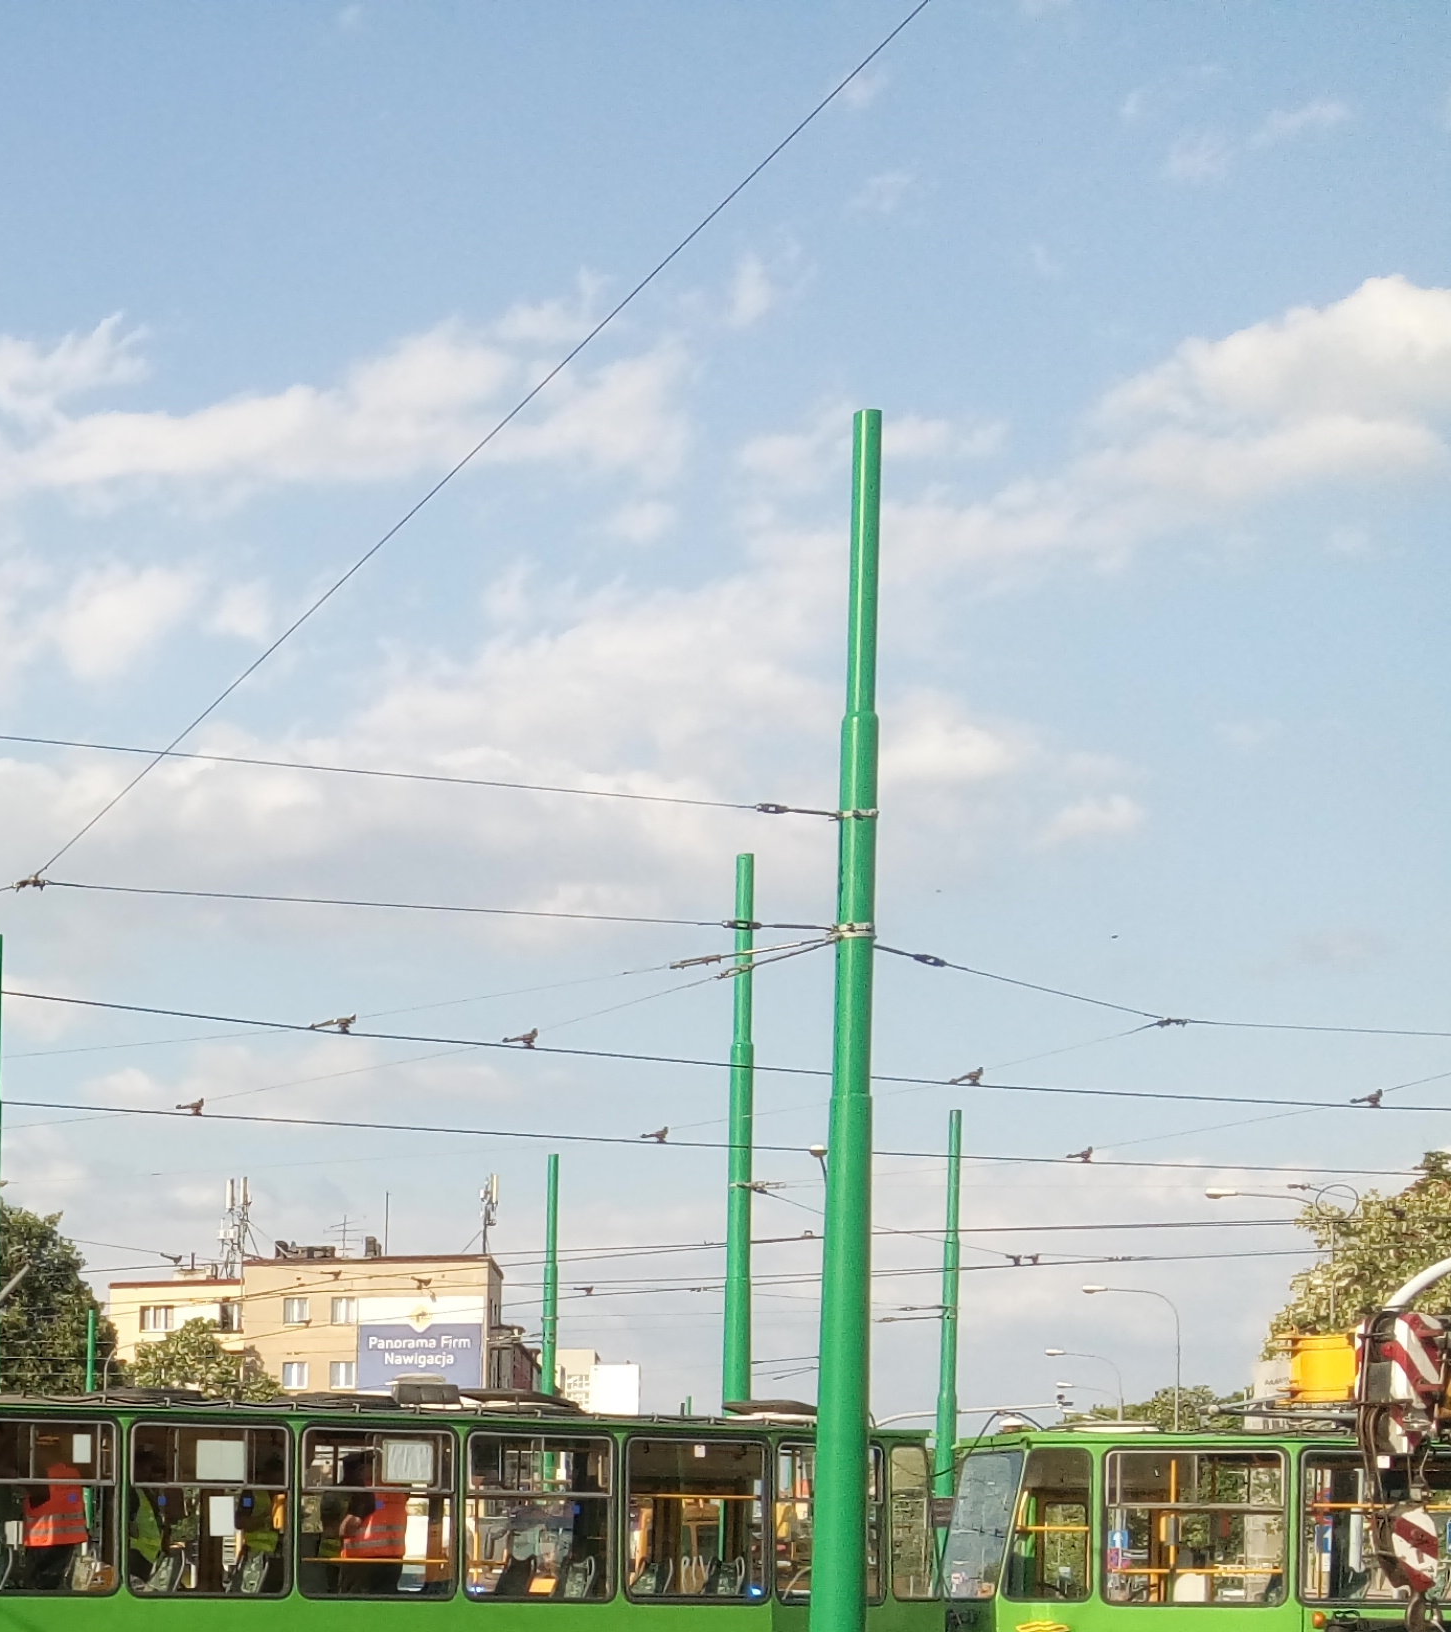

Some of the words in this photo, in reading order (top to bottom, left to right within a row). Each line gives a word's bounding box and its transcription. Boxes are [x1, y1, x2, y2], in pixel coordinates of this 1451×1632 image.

[368, 1336, 437, 1350] Panorama
[441, 1335, 472, 1349] Firm
[384, 1352, 455, 1368] Nawigacja
